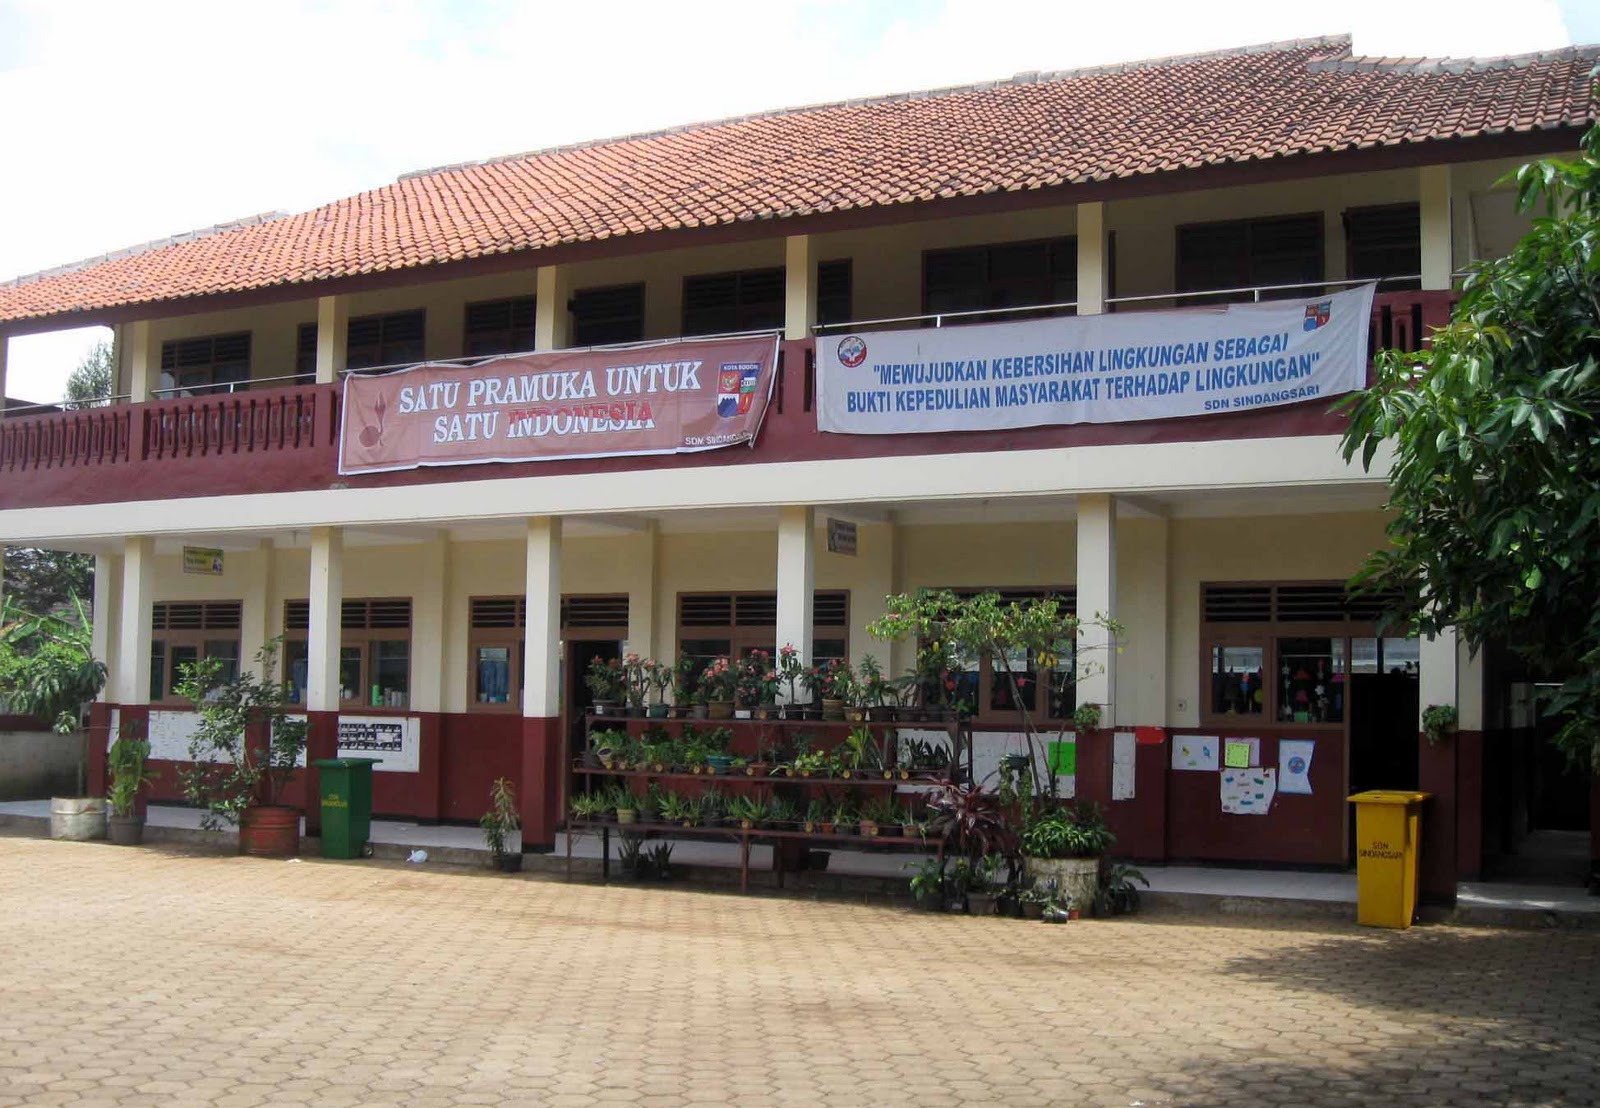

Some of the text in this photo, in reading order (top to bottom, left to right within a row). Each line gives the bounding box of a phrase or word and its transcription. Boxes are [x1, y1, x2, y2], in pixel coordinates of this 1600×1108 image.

[847, 352, 1320, 413] BUKTI KEPEDULIAN MASYARAKAT TERHADAP LINGKUNGAN"
[873, 332, 1289, 385] "MEWUJUDKAN KEBERSIHAN LINGKUNGAN SEBAGAI
[399, 360, 702, 413] SATU PRAMUKA UNTUK
[1204, 384, 1320, 410] SDN SINDANGSARI
[433, 400, 656, 442] SATU INDONESIA
